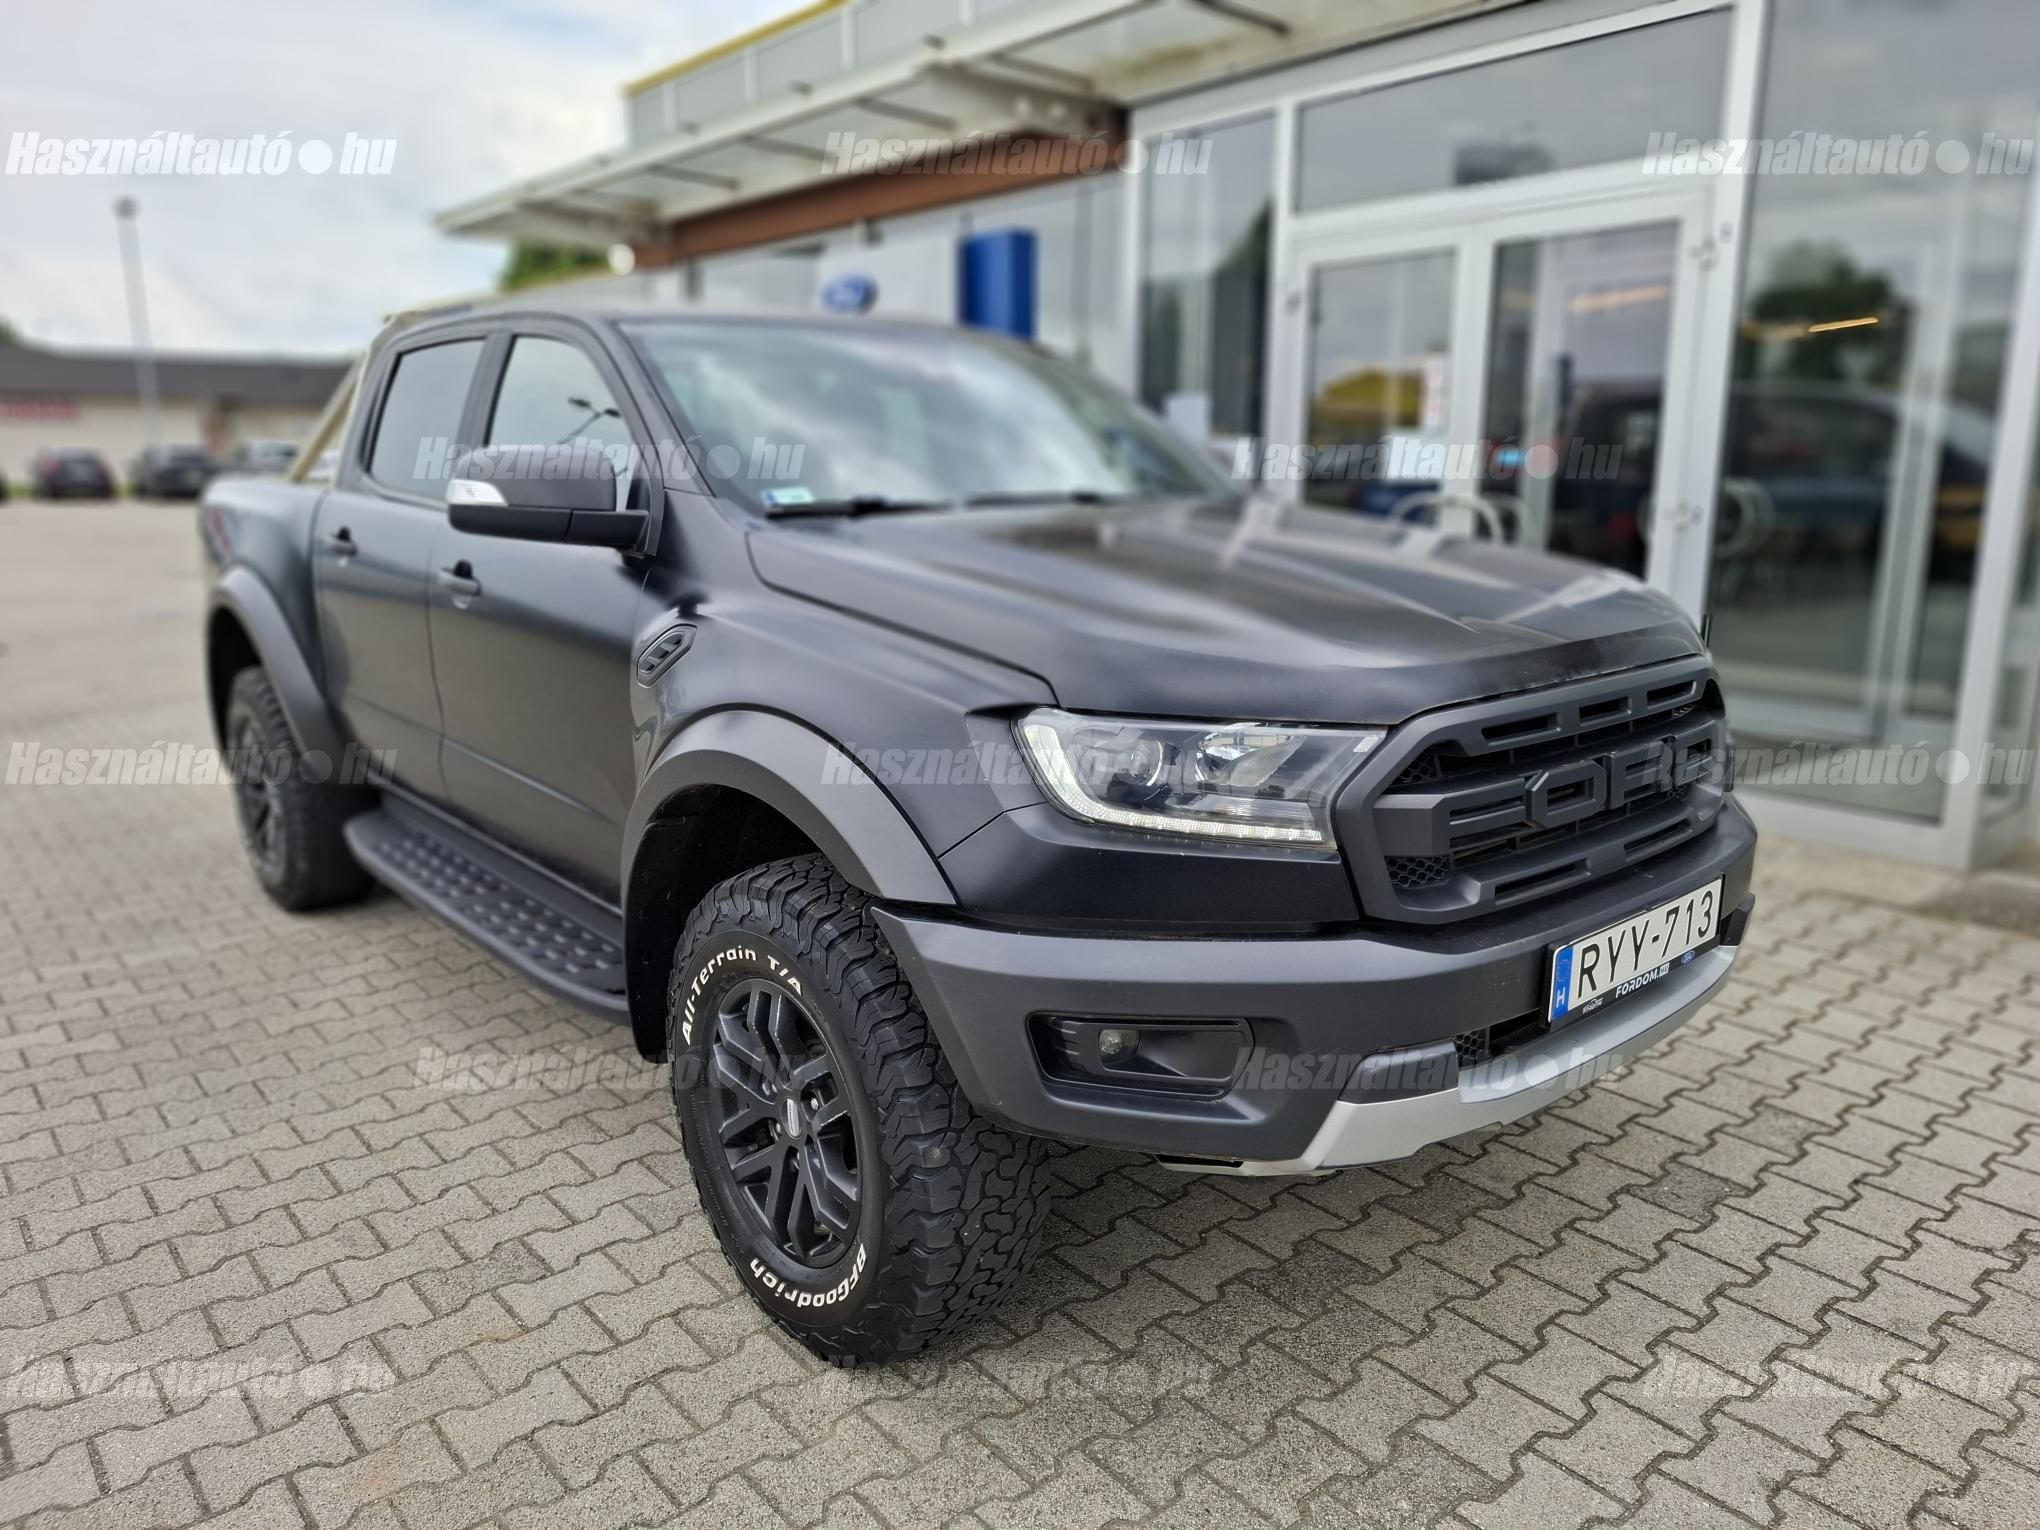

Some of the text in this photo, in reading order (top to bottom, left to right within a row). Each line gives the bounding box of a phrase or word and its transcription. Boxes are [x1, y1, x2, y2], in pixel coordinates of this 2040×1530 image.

[1577, 890, 1713, 999] RYY-713
[676, 945, 757, 1046] All-Terrain
[1556, 987, 1566, 1009] H
[750, 1243, 867, 1308] BFGoodrich
